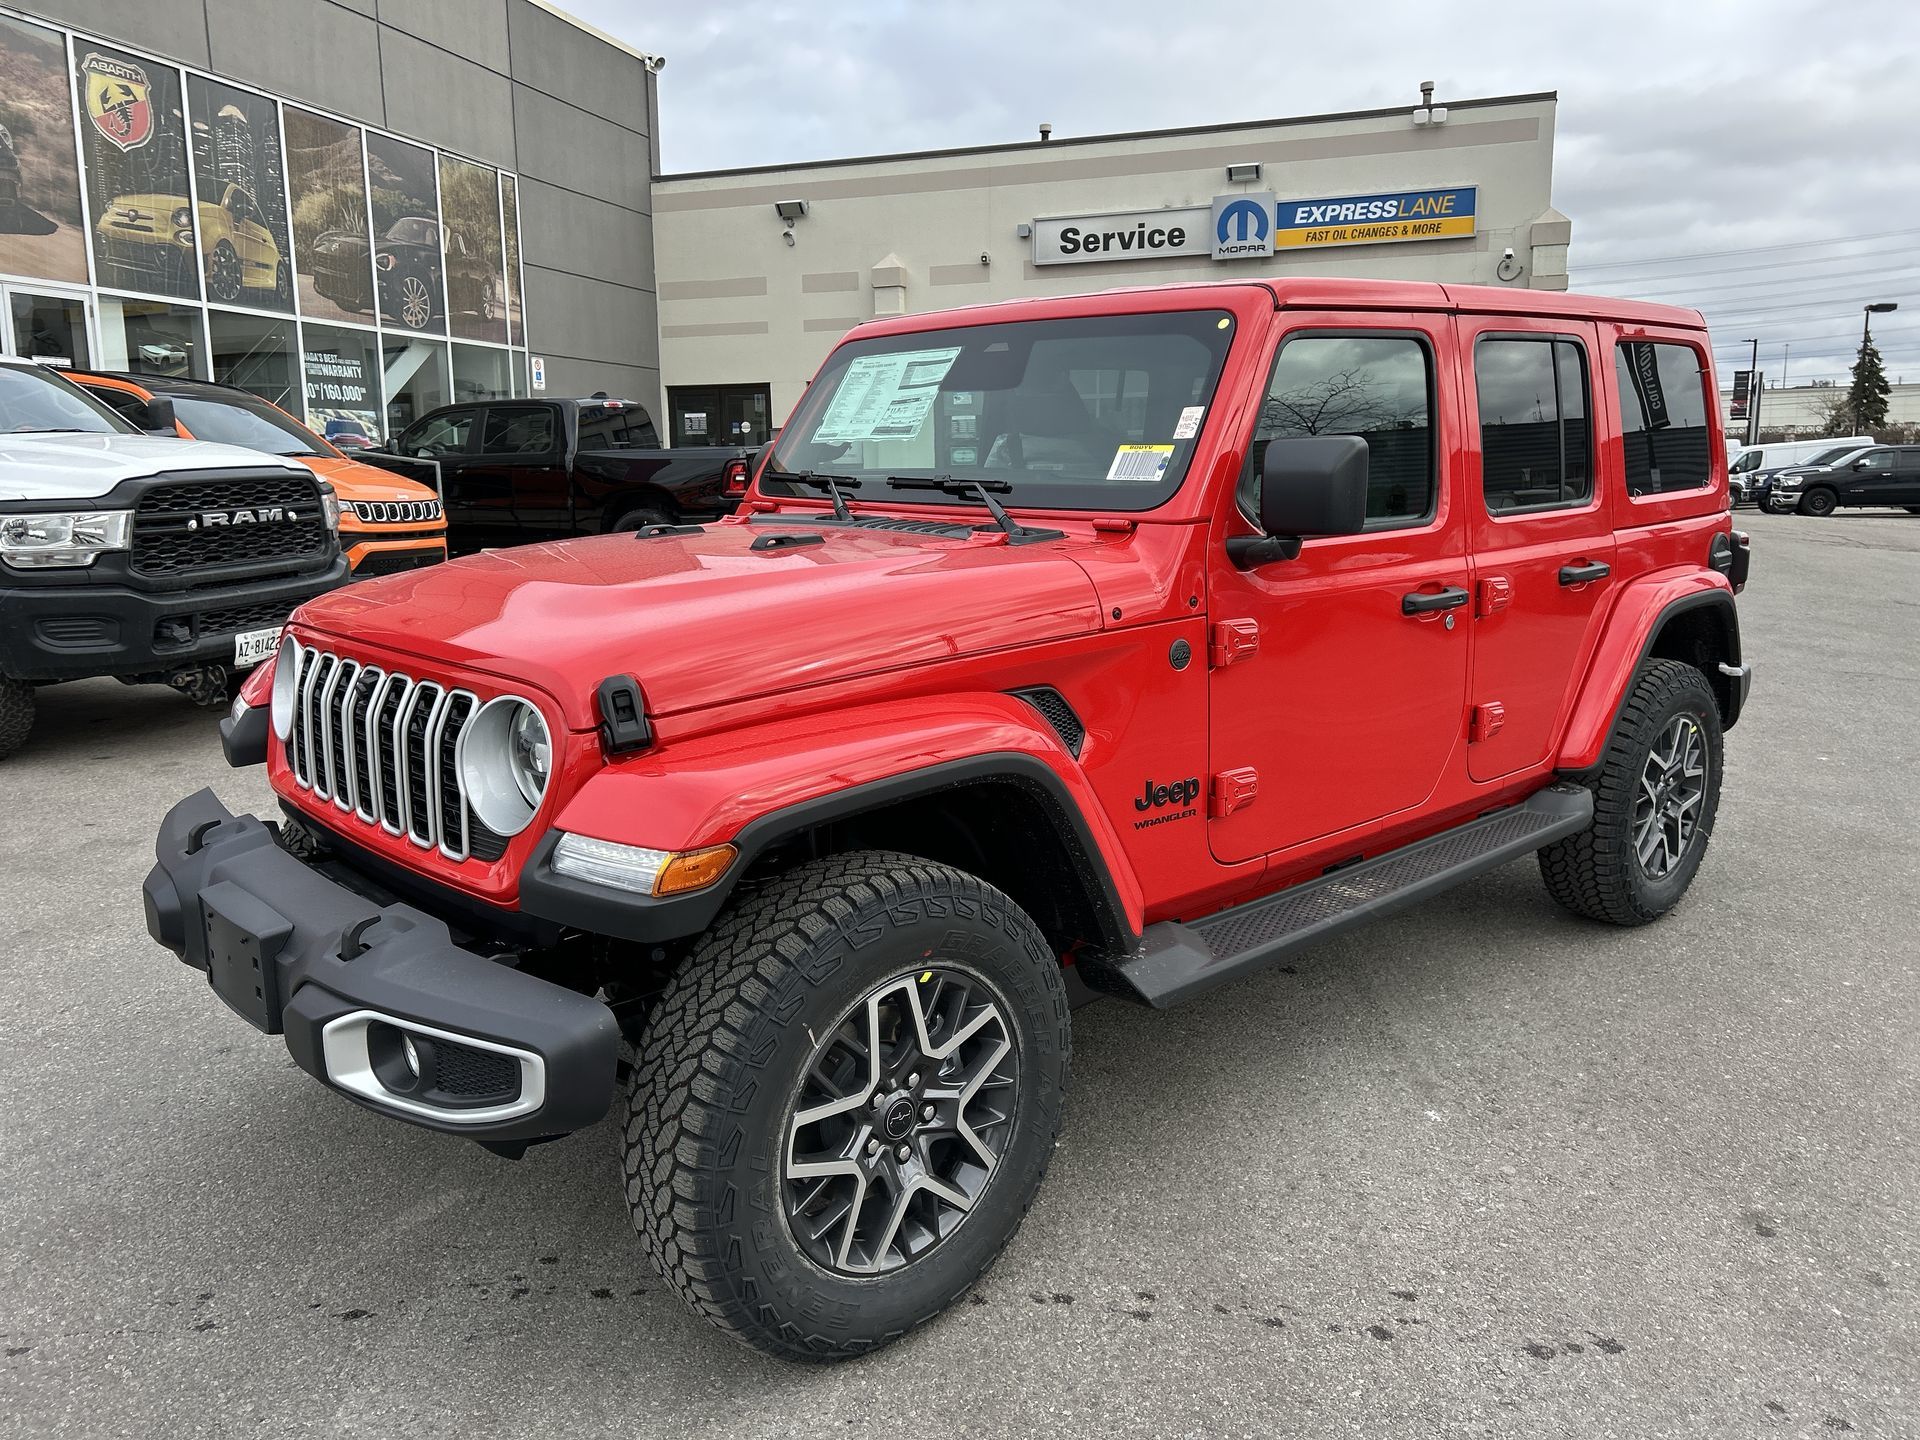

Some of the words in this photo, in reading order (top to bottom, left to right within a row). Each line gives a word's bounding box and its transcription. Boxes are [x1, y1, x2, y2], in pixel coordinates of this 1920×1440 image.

[89, 60, 141, 82] ABARTH
[1059, 222, 1186, 254] Service
[1305, 231, 1330, 242] FAST
[1332, 229, 1347, 241] OIL
[1351, 226, 1398, 239] CHANGES
[1401, 224, 1409, 235] &
[1411, 222, 1442, 234] MORE
[1218, 244, 1266, 255] MOPAR
[323, 353, 338, 364] BEST
[321, 364, 362, 378] WARRANTY
[202, 508, 283, 528] RAM
[238, 642, 250, 658] AZ
[1134, 776, 1200, 812] Jeep
[1134, 808, 1197, 830] WRANGLER
